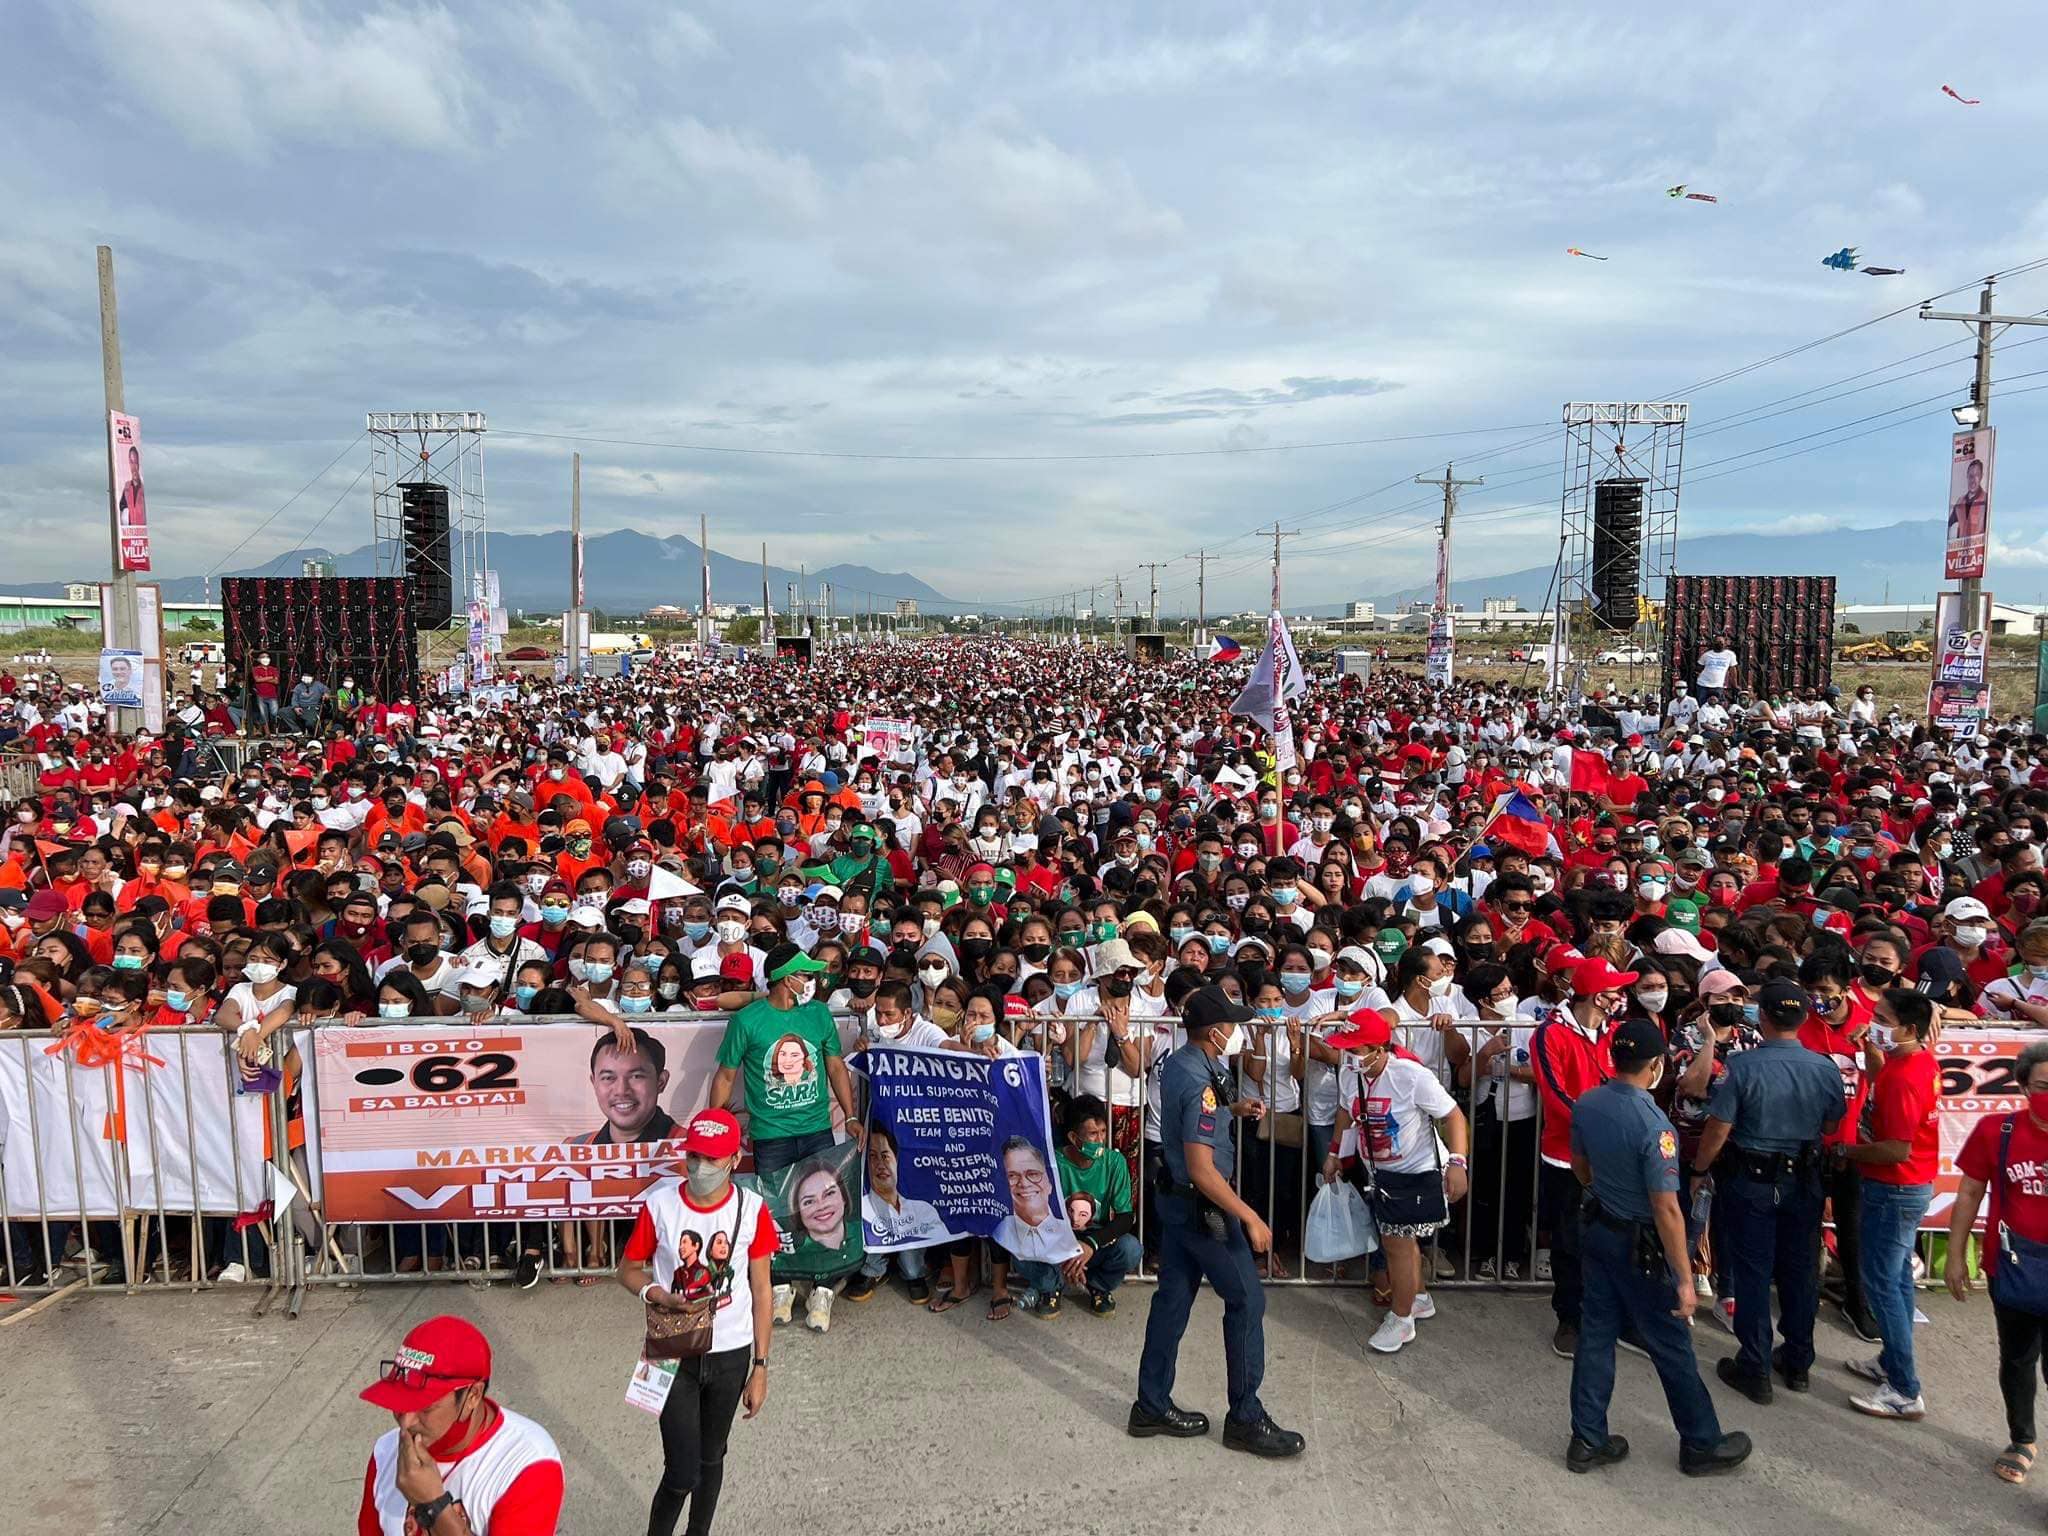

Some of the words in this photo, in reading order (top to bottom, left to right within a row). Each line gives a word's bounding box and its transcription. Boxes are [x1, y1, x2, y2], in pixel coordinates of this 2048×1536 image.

[1947, 554, 1984, 570] VILLAR
[386, 1041, 484, 1055] IBOTO
[409, 1053, 519, 1093] 62
[1003, 1063, 1020, 1088] 6
[362, 1099, 396, 1110] SA
[405, 1092, 516, 1108] BALOTA!
[766, 1080, 819, 1106] SARA
[880, 1085, 890, 1097] IN
[895, 1085, 923, 1097] FULL
[927, 1086, 979, 1099] SUPPORT
[983, 1090, 999, 1108] FOR
[897, 1107, 941, 1124] ALBEE
[944, 1107, 994, 1128] BENITEZ
[914, 1127, 942, 1137] TEAM
[416, 1143, 678, 1167] MARKABUHA
[945, 1143, 966, 1153] AND
[485, 1161, 682, 1184] MARK
[940, 1182, 995, 1194] PADUANO
[932, 1198, 968, 1207] ABANG
[475, 1208, 517, 1216] FOR
[949, 1206, 1003, 1218] PARTYLIST
